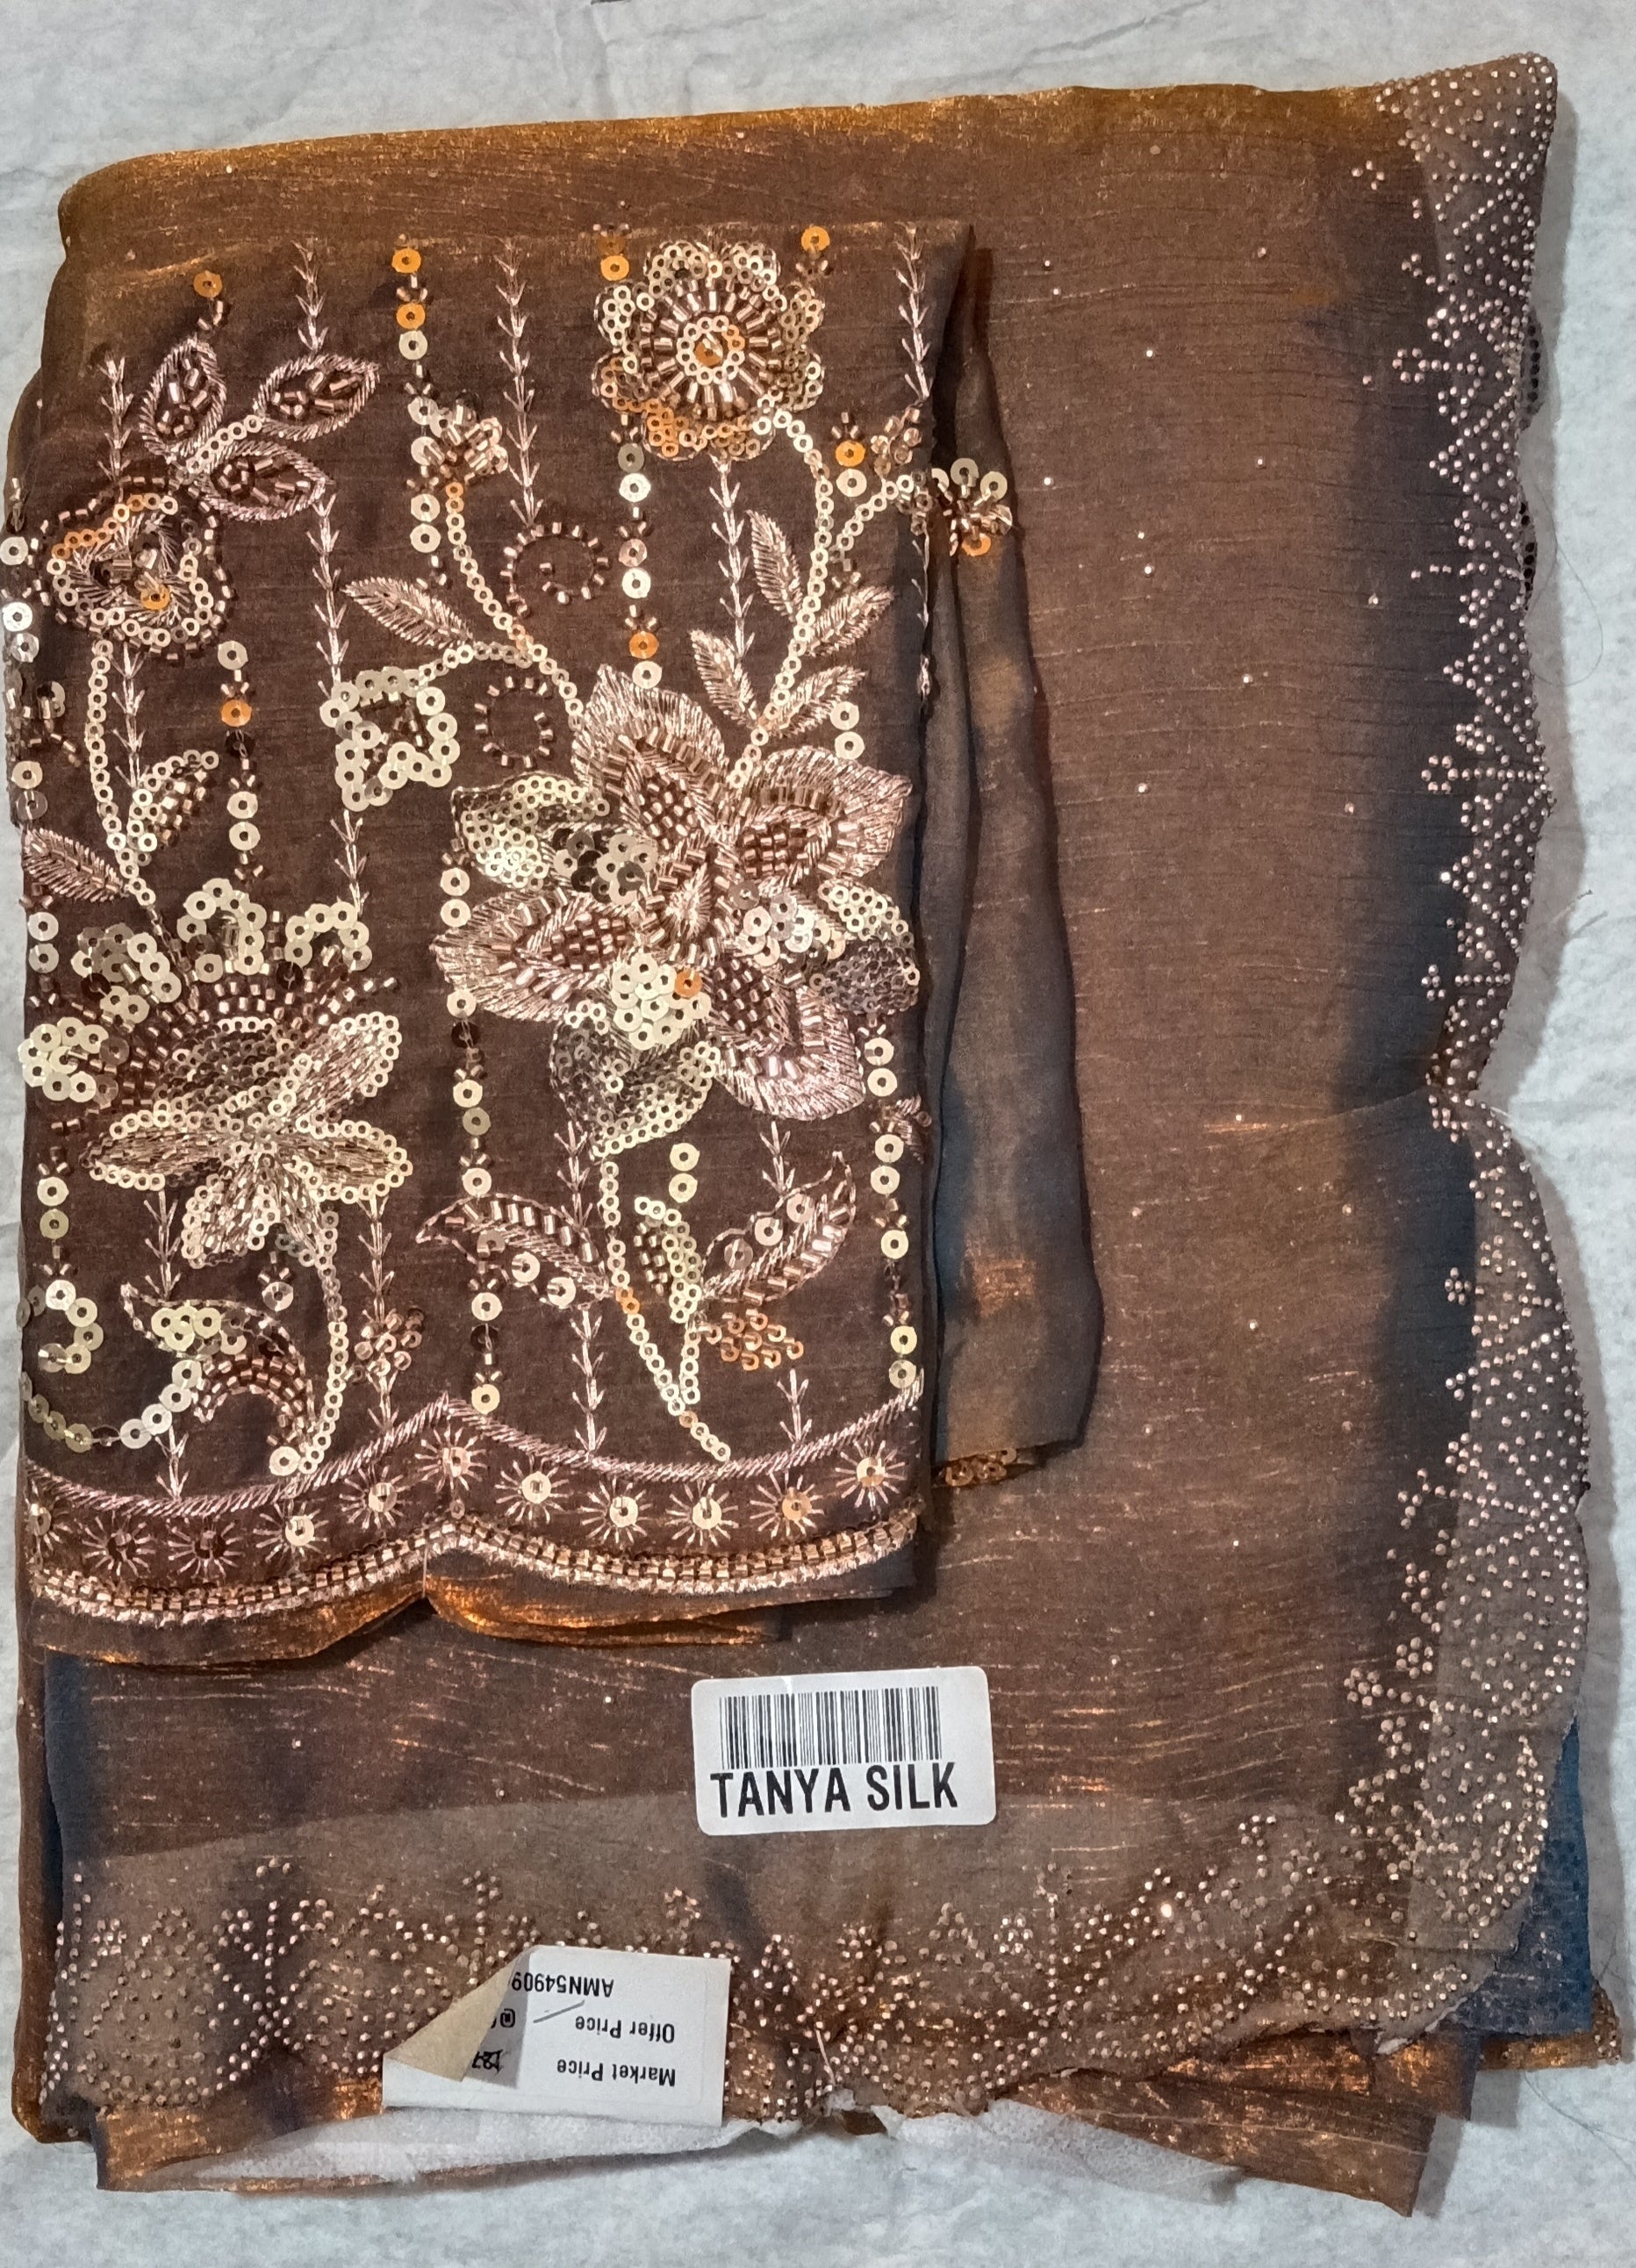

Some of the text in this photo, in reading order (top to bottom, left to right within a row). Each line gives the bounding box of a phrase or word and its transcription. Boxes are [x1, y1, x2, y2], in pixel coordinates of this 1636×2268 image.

[709, 1762, 958, 1819] TANYA SILK
[575, 2016, 622, 2039] Price
[629, 2021, 675, 2044] Offer
[556, 2059, 604, 2082] Price
[612, 2063, 676, 2087] Market
